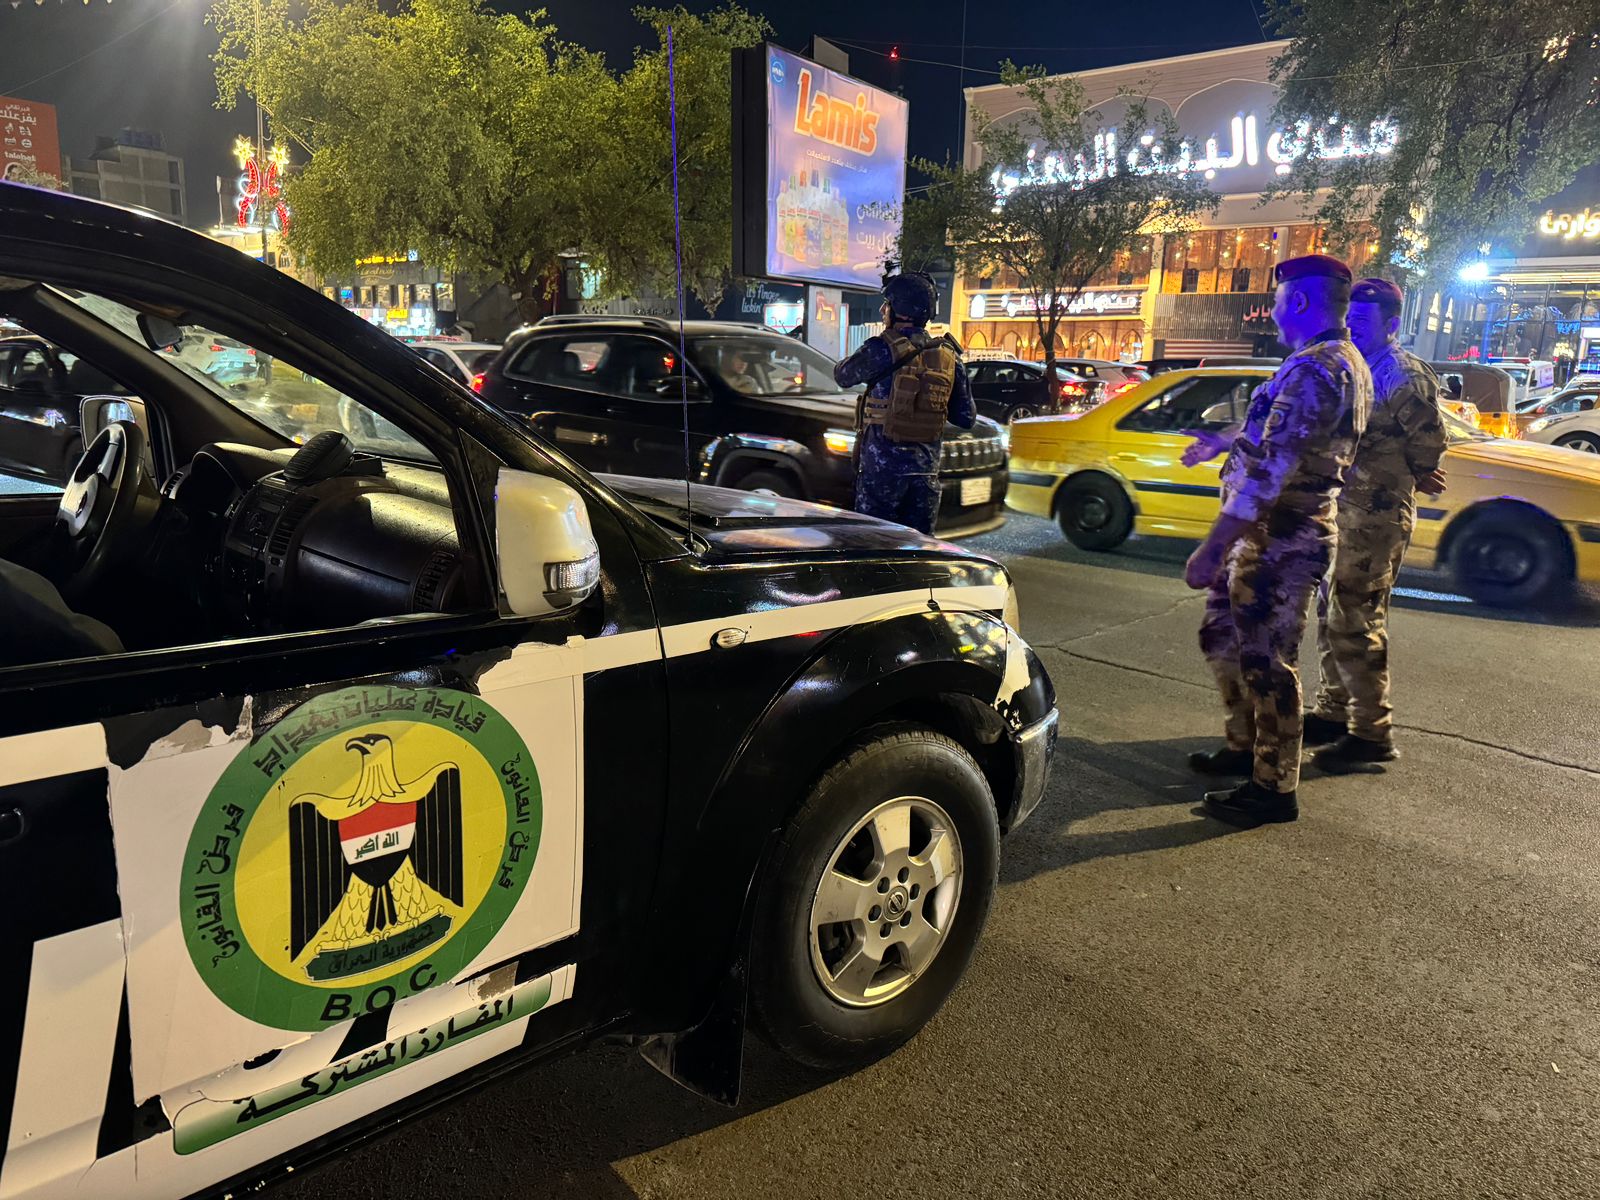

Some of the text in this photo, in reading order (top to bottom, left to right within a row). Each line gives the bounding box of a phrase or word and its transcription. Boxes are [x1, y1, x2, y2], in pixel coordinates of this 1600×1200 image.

[794, 68, 879, 156] Lamis
[4, 151, 37, 161] talabat
[1128, 116, 1258, 179] البيت
[856, 231, 876, 250] بيت
[253, 687, 488, 778] قيادة عمليات بغداد
[382, 831, 399, 849] الله
[497, 752, 531, 889] فرض القانون
[194, 803, 245, 969] فرض القانون
[328, 924, 434, 974] جمهورية العراق
